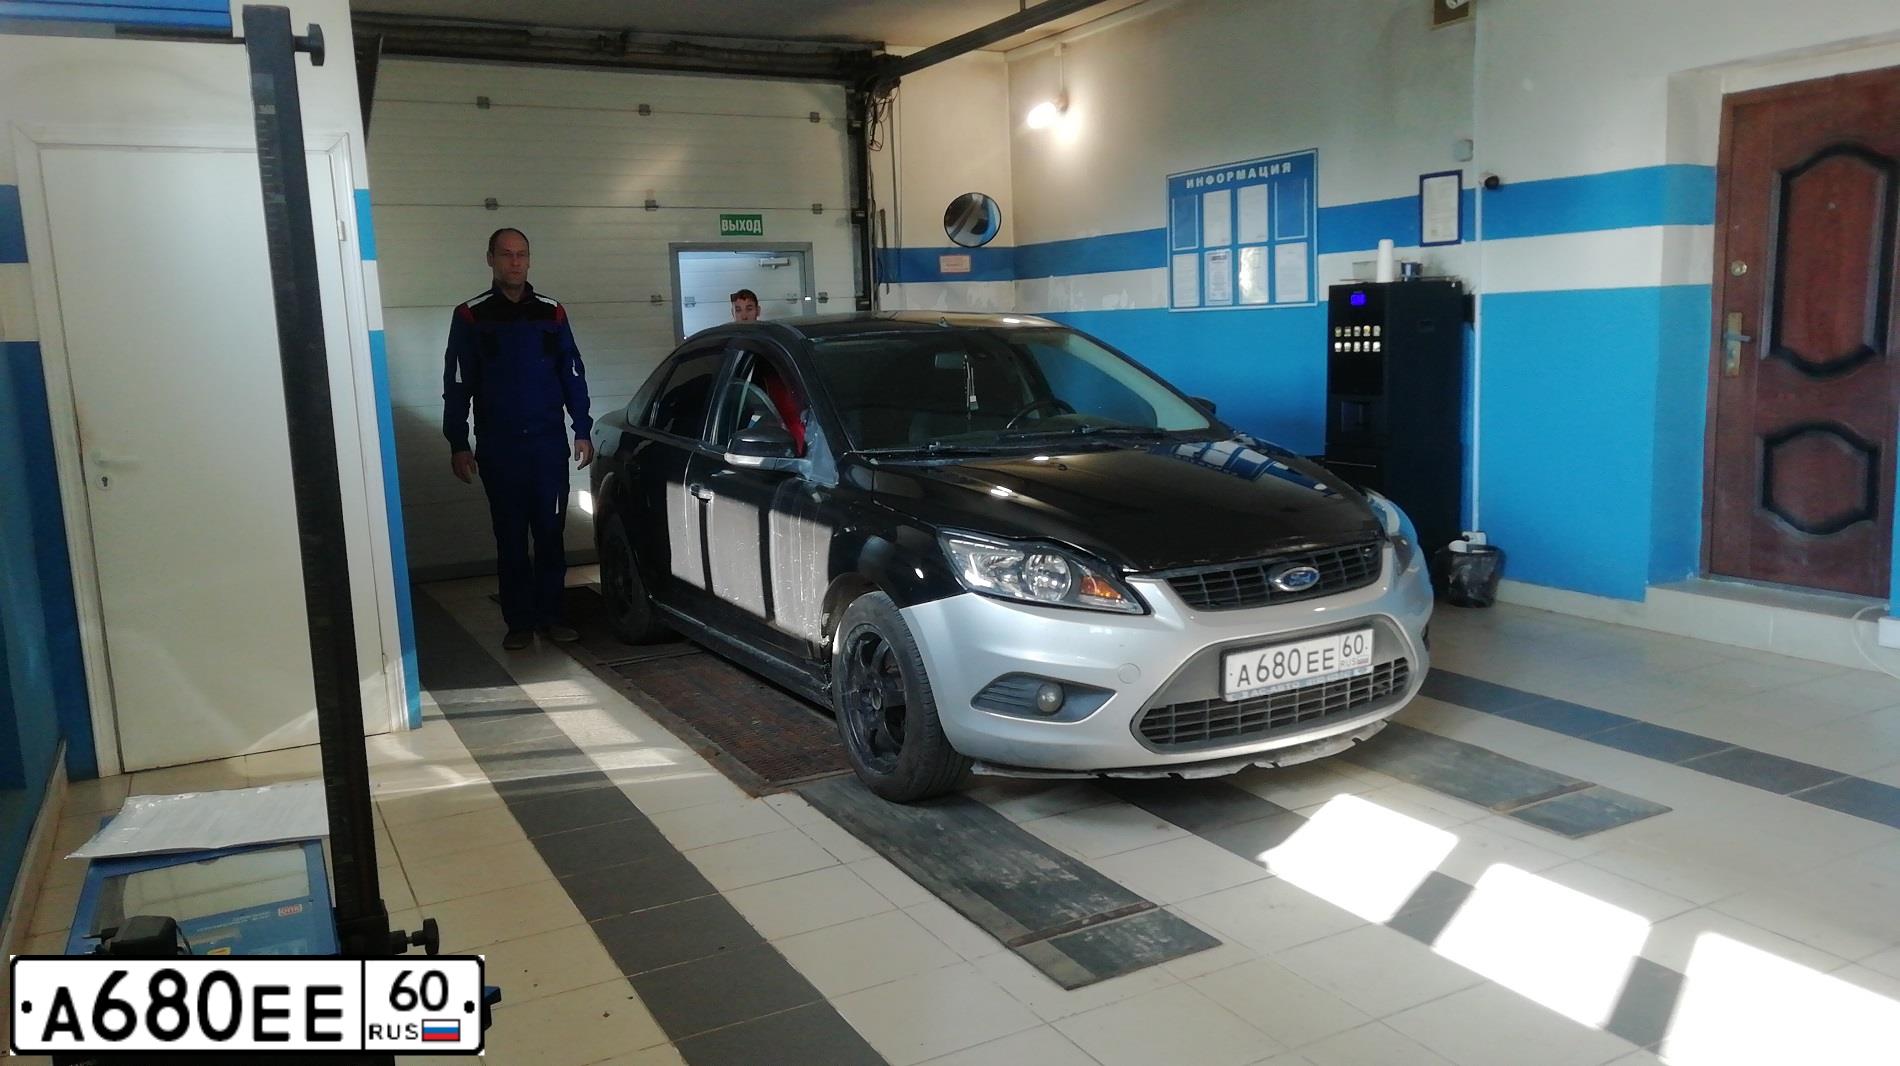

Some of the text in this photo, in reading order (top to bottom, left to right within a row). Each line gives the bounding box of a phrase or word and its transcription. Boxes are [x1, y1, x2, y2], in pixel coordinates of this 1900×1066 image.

[1186, 162, 1291, 188] ИНФОРМАЦИЯ
[721, 219, 762, 233] ВЫХОД
[1342, 634, 1364, 657] 60
